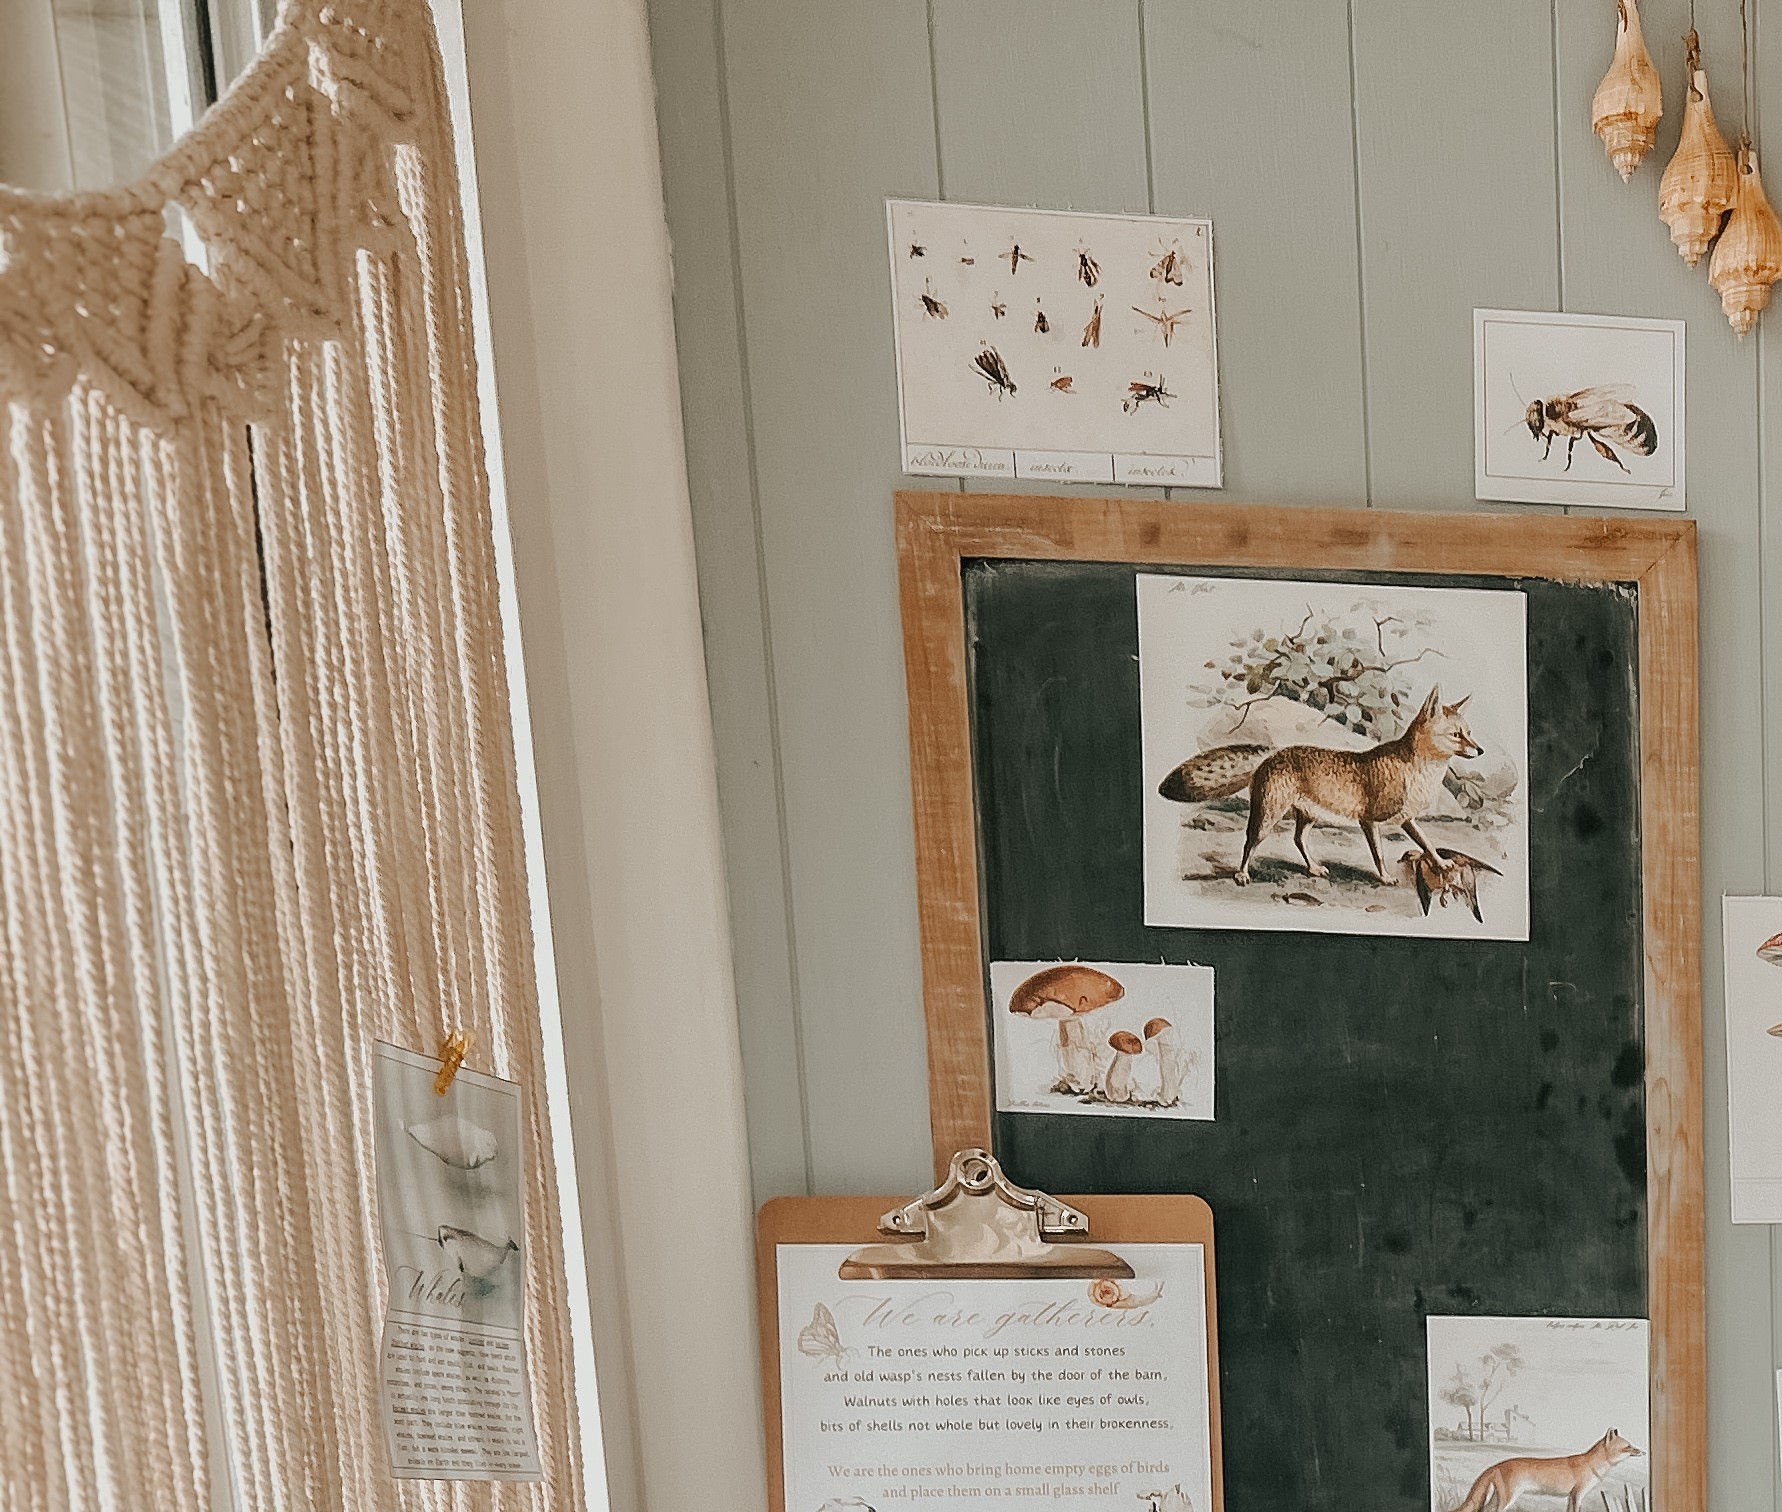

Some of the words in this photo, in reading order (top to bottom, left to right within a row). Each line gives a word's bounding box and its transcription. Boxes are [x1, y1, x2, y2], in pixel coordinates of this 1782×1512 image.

[933, 1310, 984, 1328] are
[867, 1344, 893, 1358] The
[897, 1347, 928, 1359] ones
[932, 1344, 959, 1358] who
[963, 1346, 989, 1360] pick
[993, 1346, 1010, 1360] up
[1013, 1346, 1050, 1357] sticks
[1054, 1344, 1079, 1357] and
[1084, 1346, 1126, 1358] stones
[823, 1371, 849, 1384] and
[853, 1369, 874, 1383] old
[927, 1371, 963, 1383] nests
[966, 1368, 1006, 1383] fallen
[1011, 1367, 1026, 1385] by
[1030, 1368, 1053, 1382] the
[1058, 1368, 1085, 1382] door
[1089, 1368, 1103, 1382] of
[1108, 1368, 1130, 1382] the
[843, 1395, 898, 1409] Walnuts
[902, 1394, 931, 1407] with
[935, 1393, 969, 1407] holes
[973, 1393, 1002, 1407] that
[1007, 1393, 1033, 1407] look
[1038, 1393, 1062, 1407] like
[1066, 1395, 1095, 1410] eyes
[1099, 1392, 1113, 1407] of
[820, 1419, 844, 1434] bits
[848, 1419, 863, 1433] of
[866, 1418, 904, 1433] shells
[908, 1420, 931, 1432] not
[935, 1417, 974, 1432] whole
[978, 1417, 1000, 1432] but
[1006, 1417, 1043, 1434] lovely
[1048, 1420, 1060, 1431] in
[1065, 1417, 1095, 1431] their
[827, 1464, 851, 1478] We
[853, 1467, 875, 1478] are
[877, 1463, 899, 1477] the
[901, 1466, 932, 1477] ones
[934, 1463, 964, 1477] who
[966, 1462, 1001, 1479] bring
[1004, 1461, 1042, 1475] home
[1044, 1463, 1085, 1478] empty
[1088, 1464, 1118, 1478] eggs
[1120, 1460, 1136, 1474] of
[1136, 1460, 1170, 1474] birds
[882, 1484, 907, 1498] and
[910, 1484, 945, 1500] place
[947, 1484, 981, 1498] them
[984, 1486, 1001, 1497] on
[1004, 1486, 1013, 1497] a
[1015, 1482, 1050, 1497] small
[1053, 1483, 1085, 1499] glass
[1087, 1481, 1121, 1496] shelf
